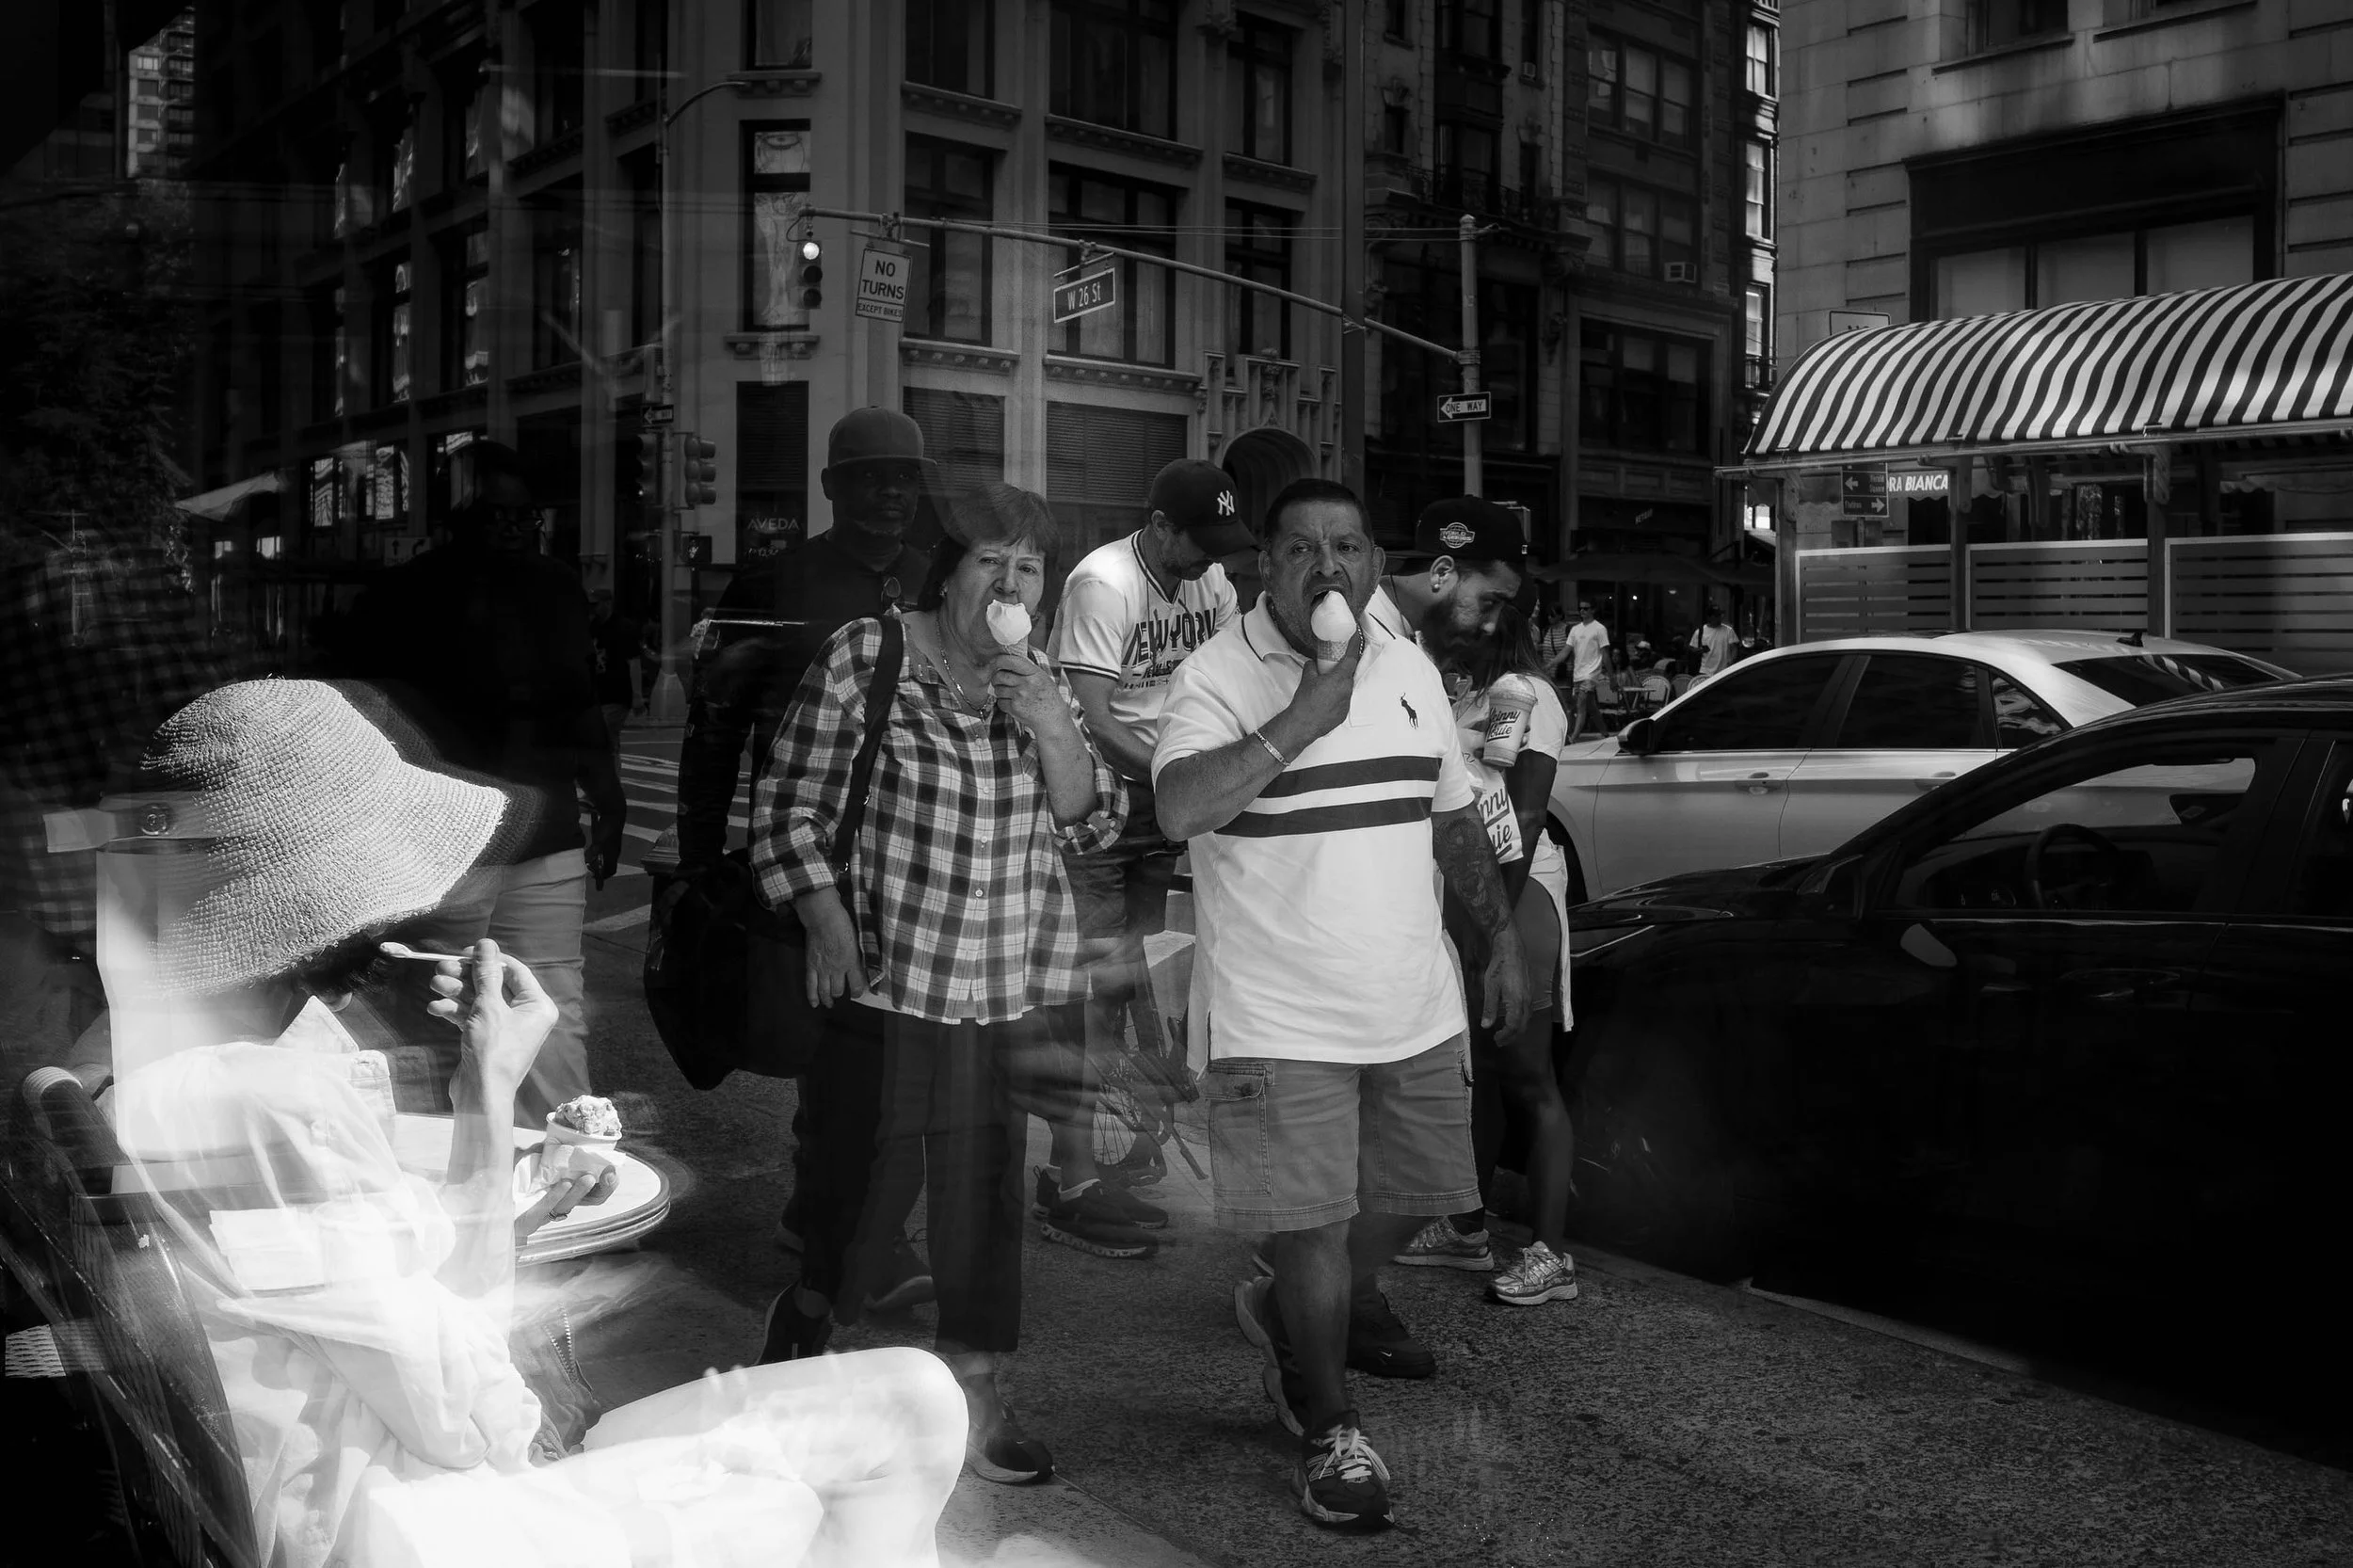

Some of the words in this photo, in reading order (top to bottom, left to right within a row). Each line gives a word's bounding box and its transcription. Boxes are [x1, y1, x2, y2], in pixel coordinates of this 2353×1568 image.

[875, 260, 896, 277] NO
[862, 280, 904, 299] TURNS
[1067, 290, 1076, 311] W
[1079, 286, 1089, 307] 26
[1093, 281, 1101, 303] St
[857, 303, 883, 313] EXCEPT
[1447, 403, 1461, 411] ONE
[1467, 400, 1483, 411] WAY
[1905, 474, 1949, 490] BIANCA
[747, 518, 800, 531] AVEDA
